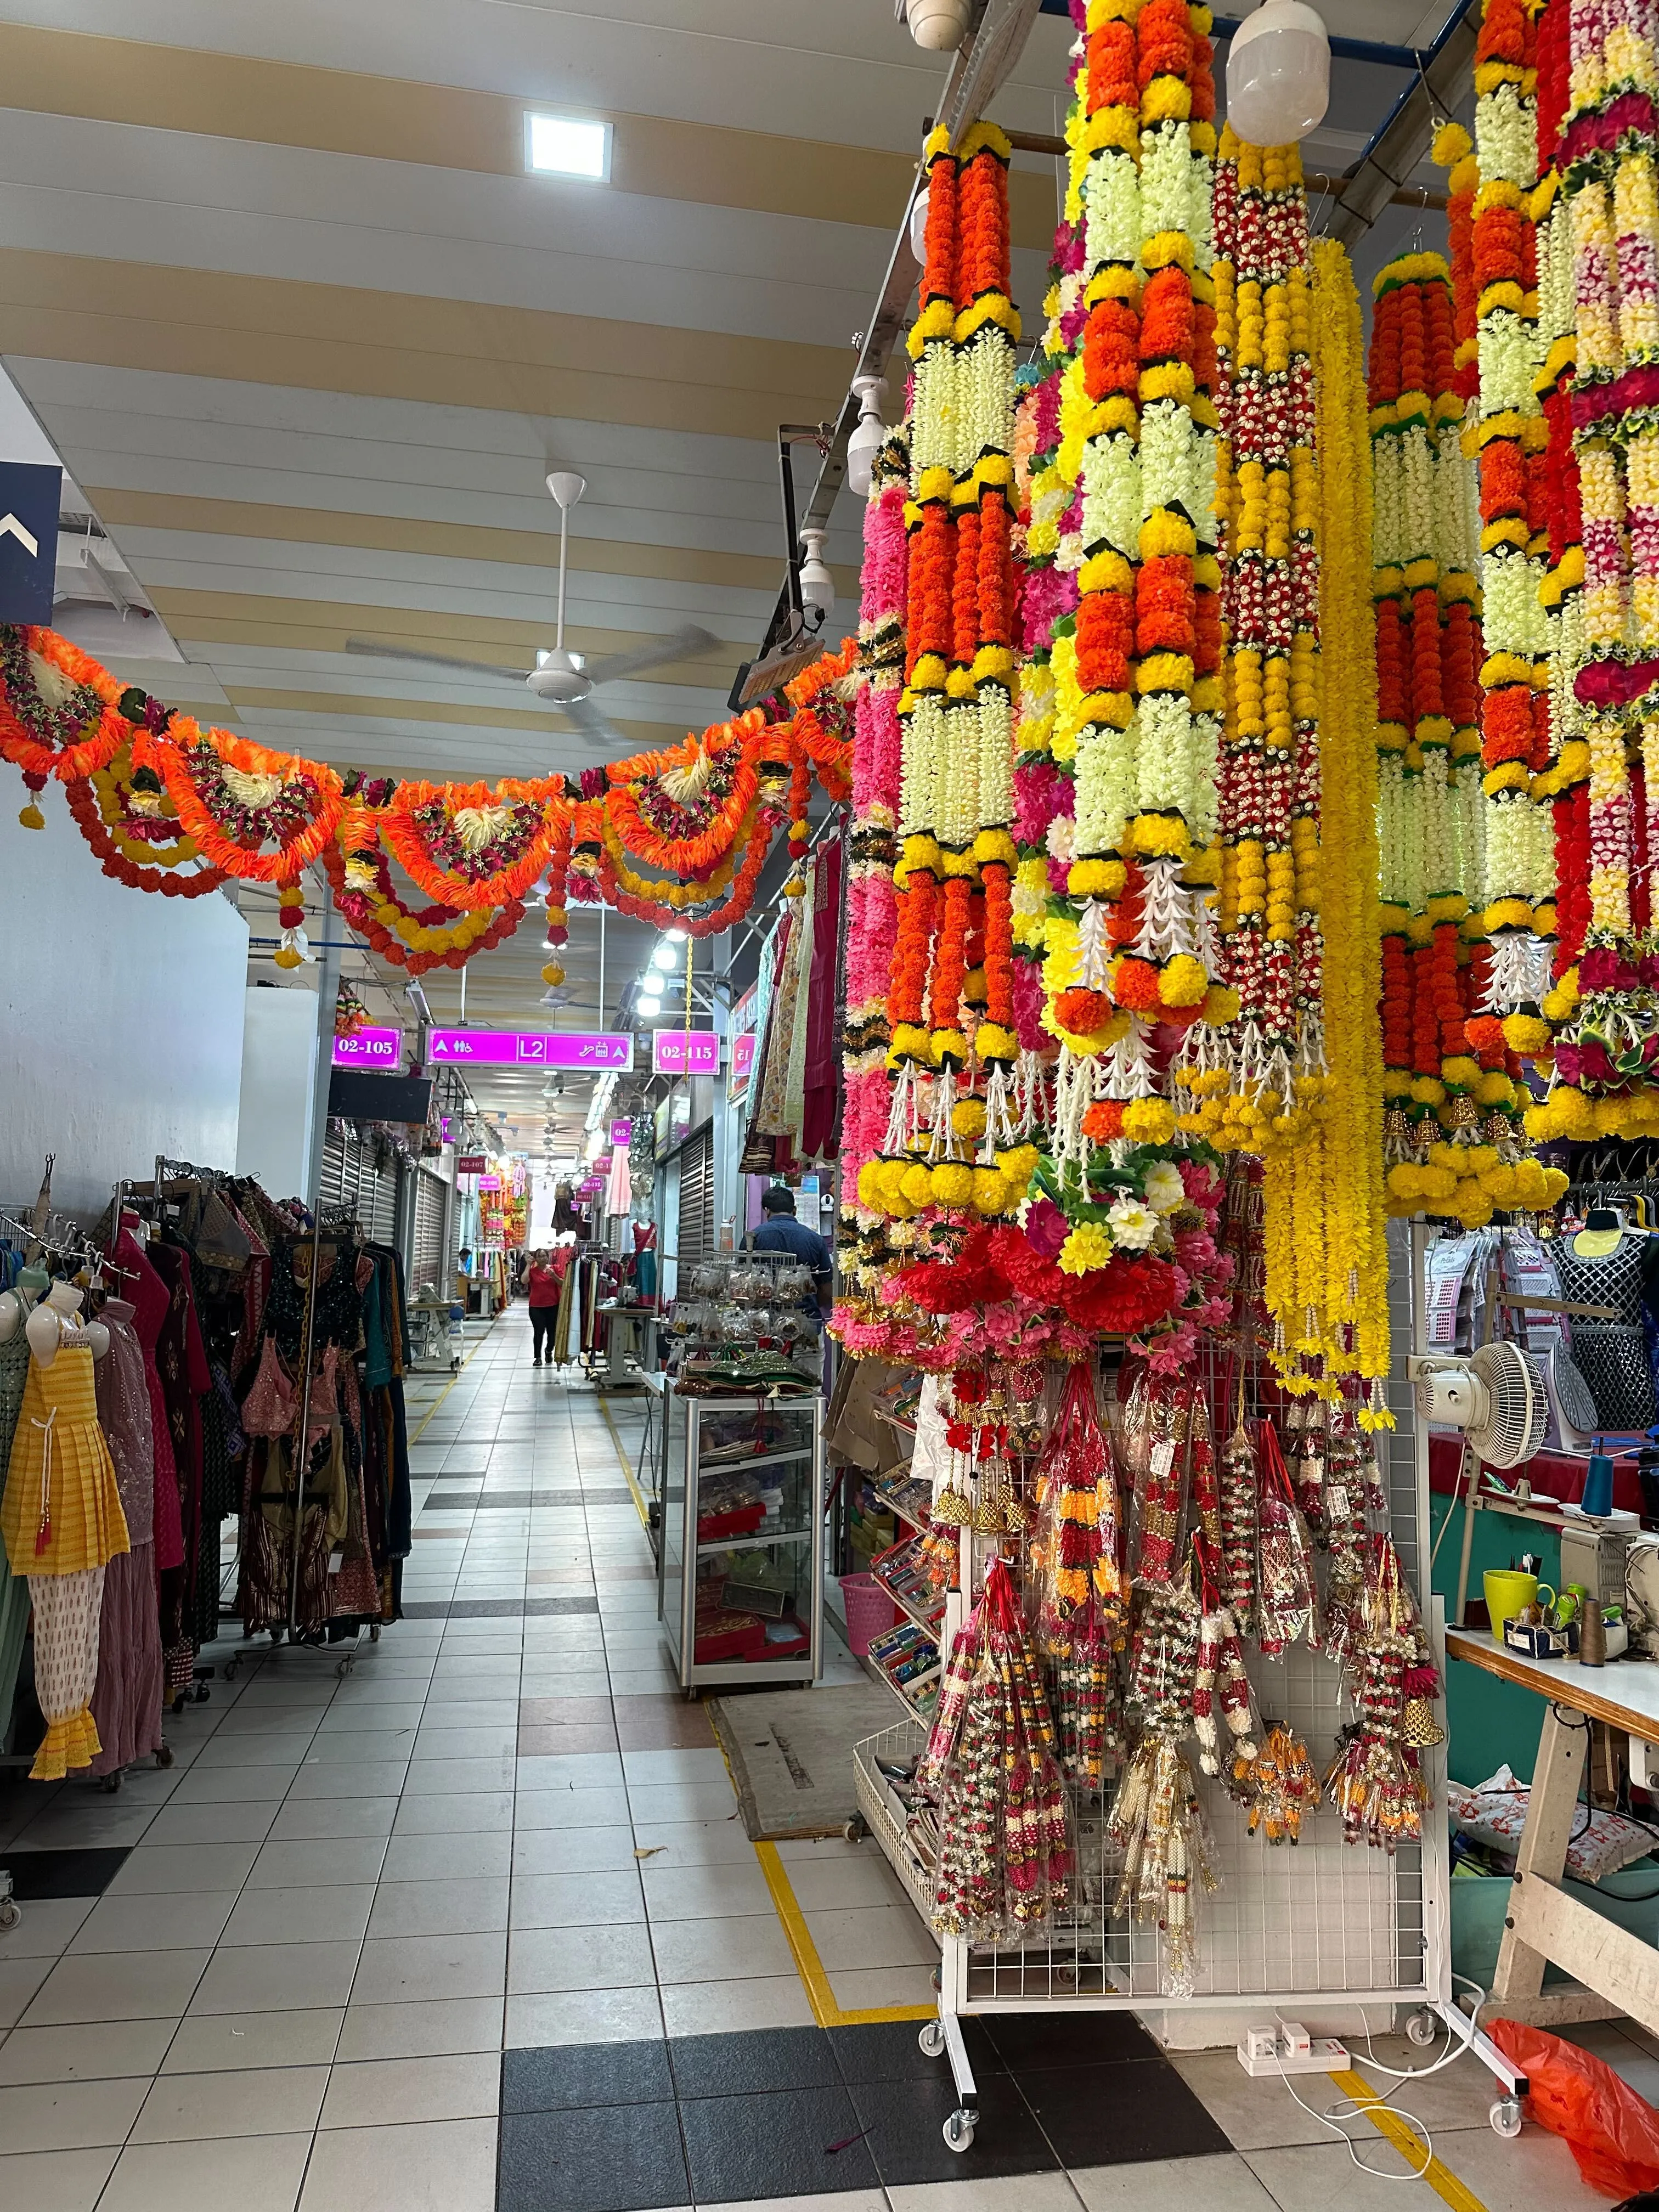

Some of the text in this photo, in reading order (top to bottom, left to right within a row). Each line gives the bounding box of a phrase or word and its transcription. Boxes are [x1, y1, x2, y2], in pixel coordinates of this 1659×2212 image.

[338, 1039, 393, 1054] 02-105
[520, 1040, 543, 1058] L2
[662, 1046, 713, 1059] 02-115
